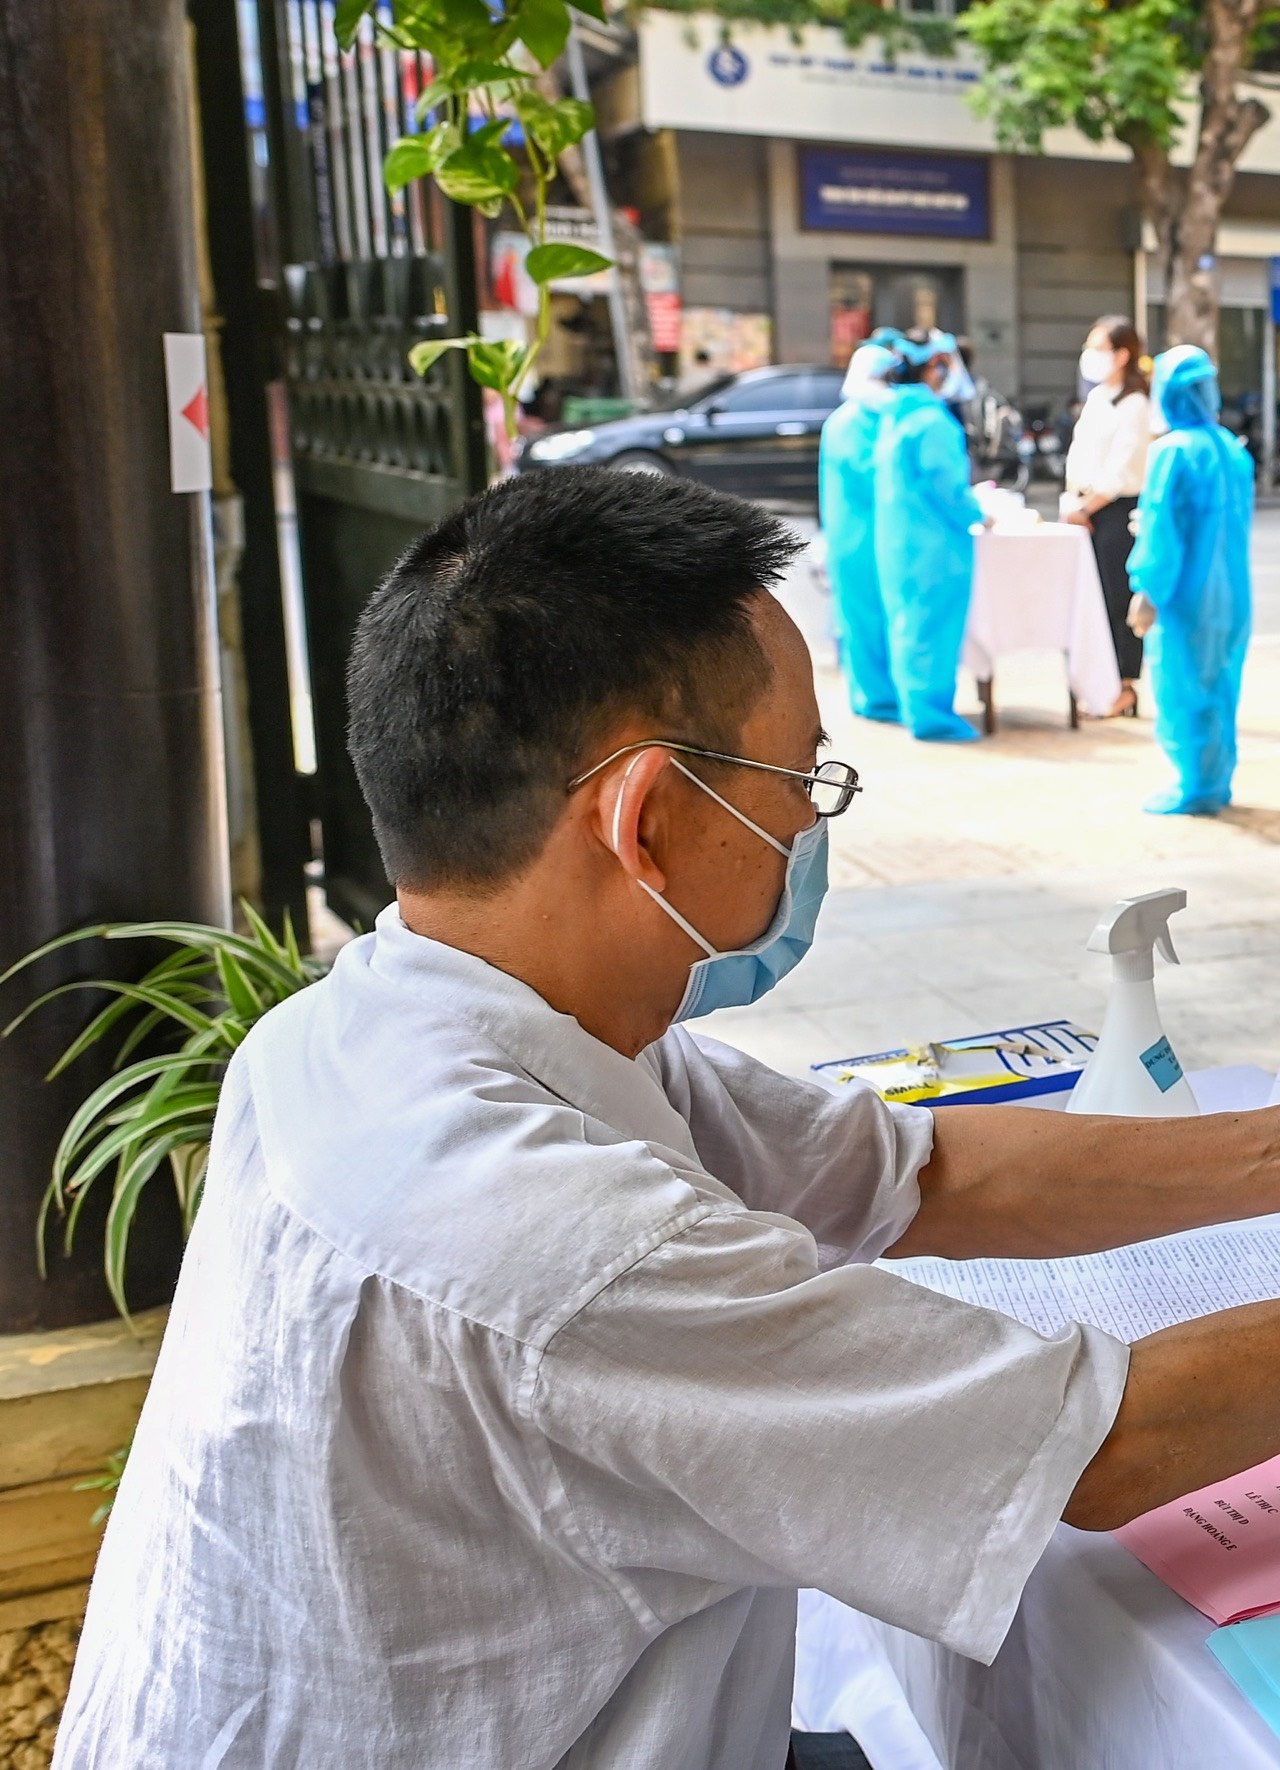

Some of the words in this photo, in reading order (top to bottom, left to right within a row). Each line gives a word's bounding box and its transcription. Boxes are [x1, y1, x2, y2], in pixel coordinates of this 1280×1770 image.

[885, 1082, 935, 1096] SMALL
[1214, 1500, 1232, 1510] BÙI
[1226, 1509, 1244, 1521] THỊ
[1245, 1492, 1262, 1500] LÊ
[1255, 1499, 1273, 1510] THỊ
[1201, 1523, 1231, 1546] HOÀNG
